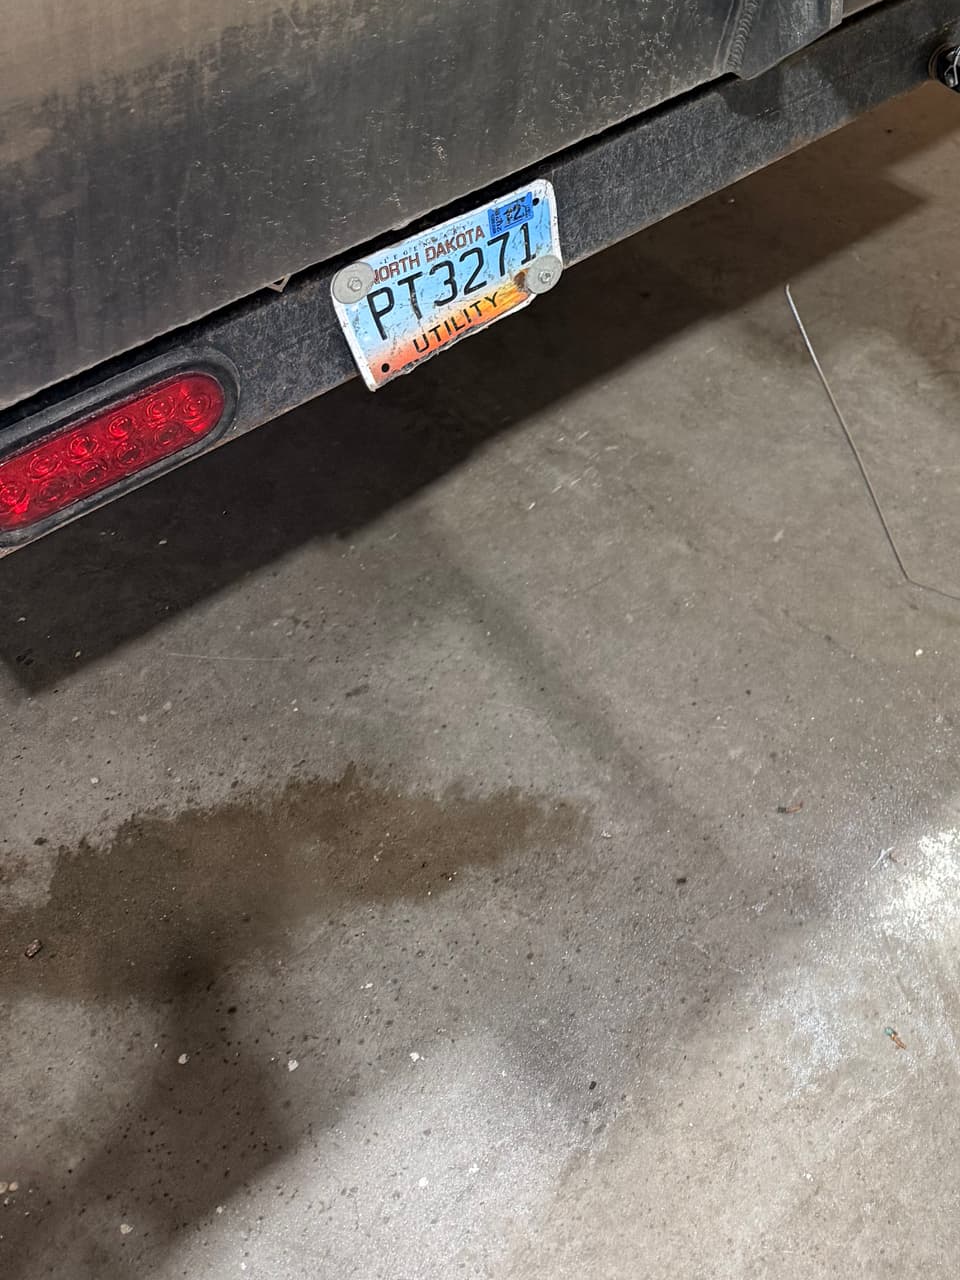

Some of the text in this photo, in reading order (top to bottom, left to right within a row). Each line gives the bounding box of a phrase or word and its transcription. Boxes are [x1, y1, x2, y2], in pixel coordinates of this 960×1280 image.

[425, 225, 485, 263] DAKOTA
[367, 222, 537, 340] PT3271
[413, 292, 498, 353] UTILITY
